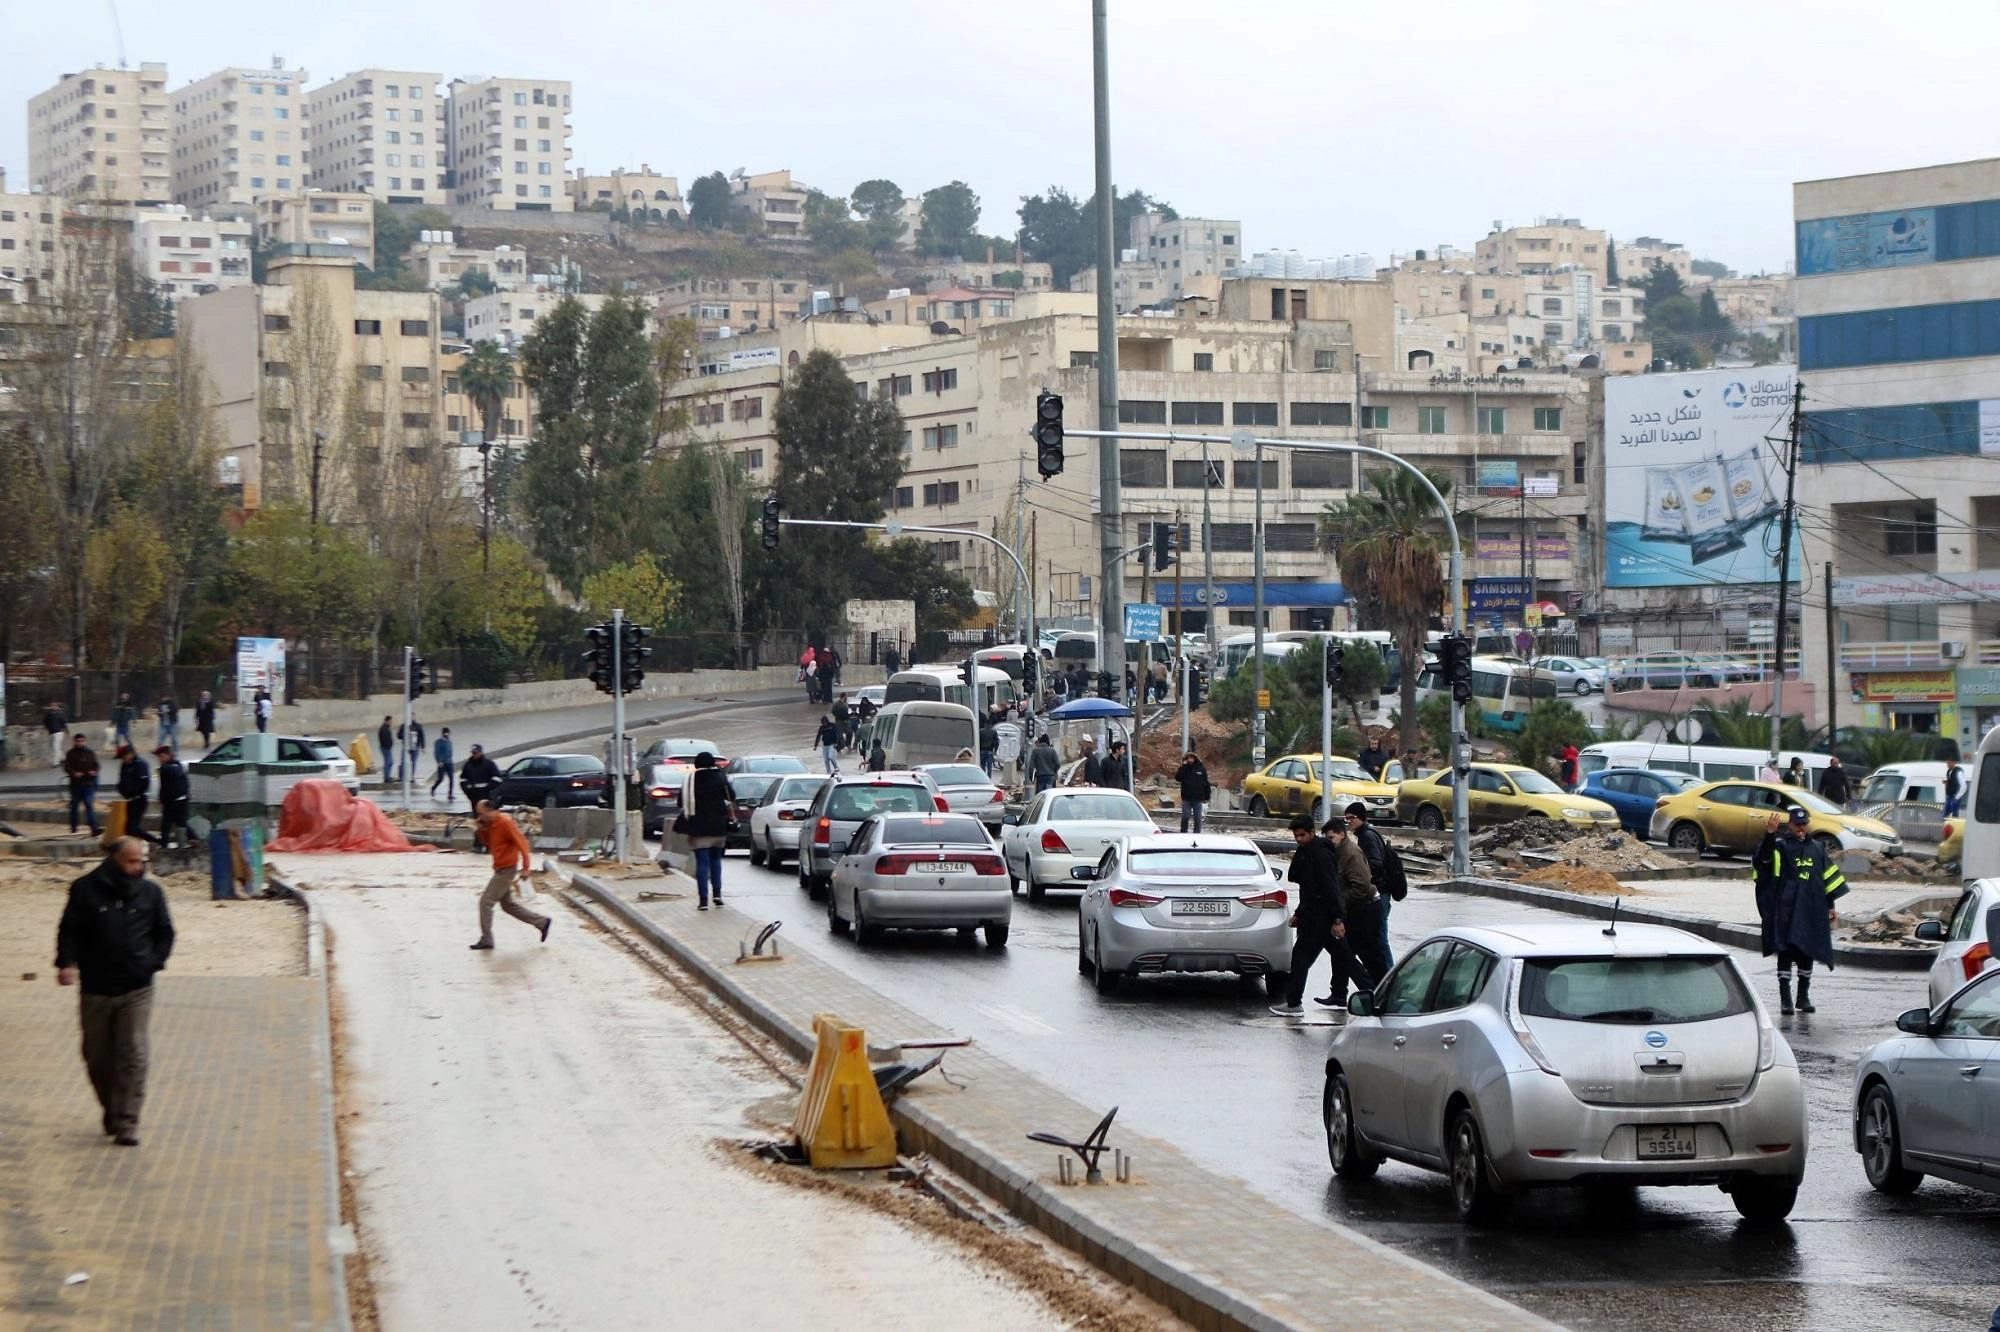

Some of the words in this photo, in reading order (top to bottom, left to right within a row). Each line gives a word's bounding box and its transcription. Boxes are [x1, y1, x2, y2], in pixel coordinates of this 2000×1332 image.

[1630, 411, 1661, 426] جديد
[1667, 405, 1701, 425] شكل
[1620, 429, 1657, 448] الفريد
[1661, 427, 1702, 443] لصيدنا
[1182, 903, 1195, 913] 22
[1197, 903, 1229, 913] 56613
[1661, 1127, 1678, 1140] 21
[1648, 1140, 1694, 1154] 99544
